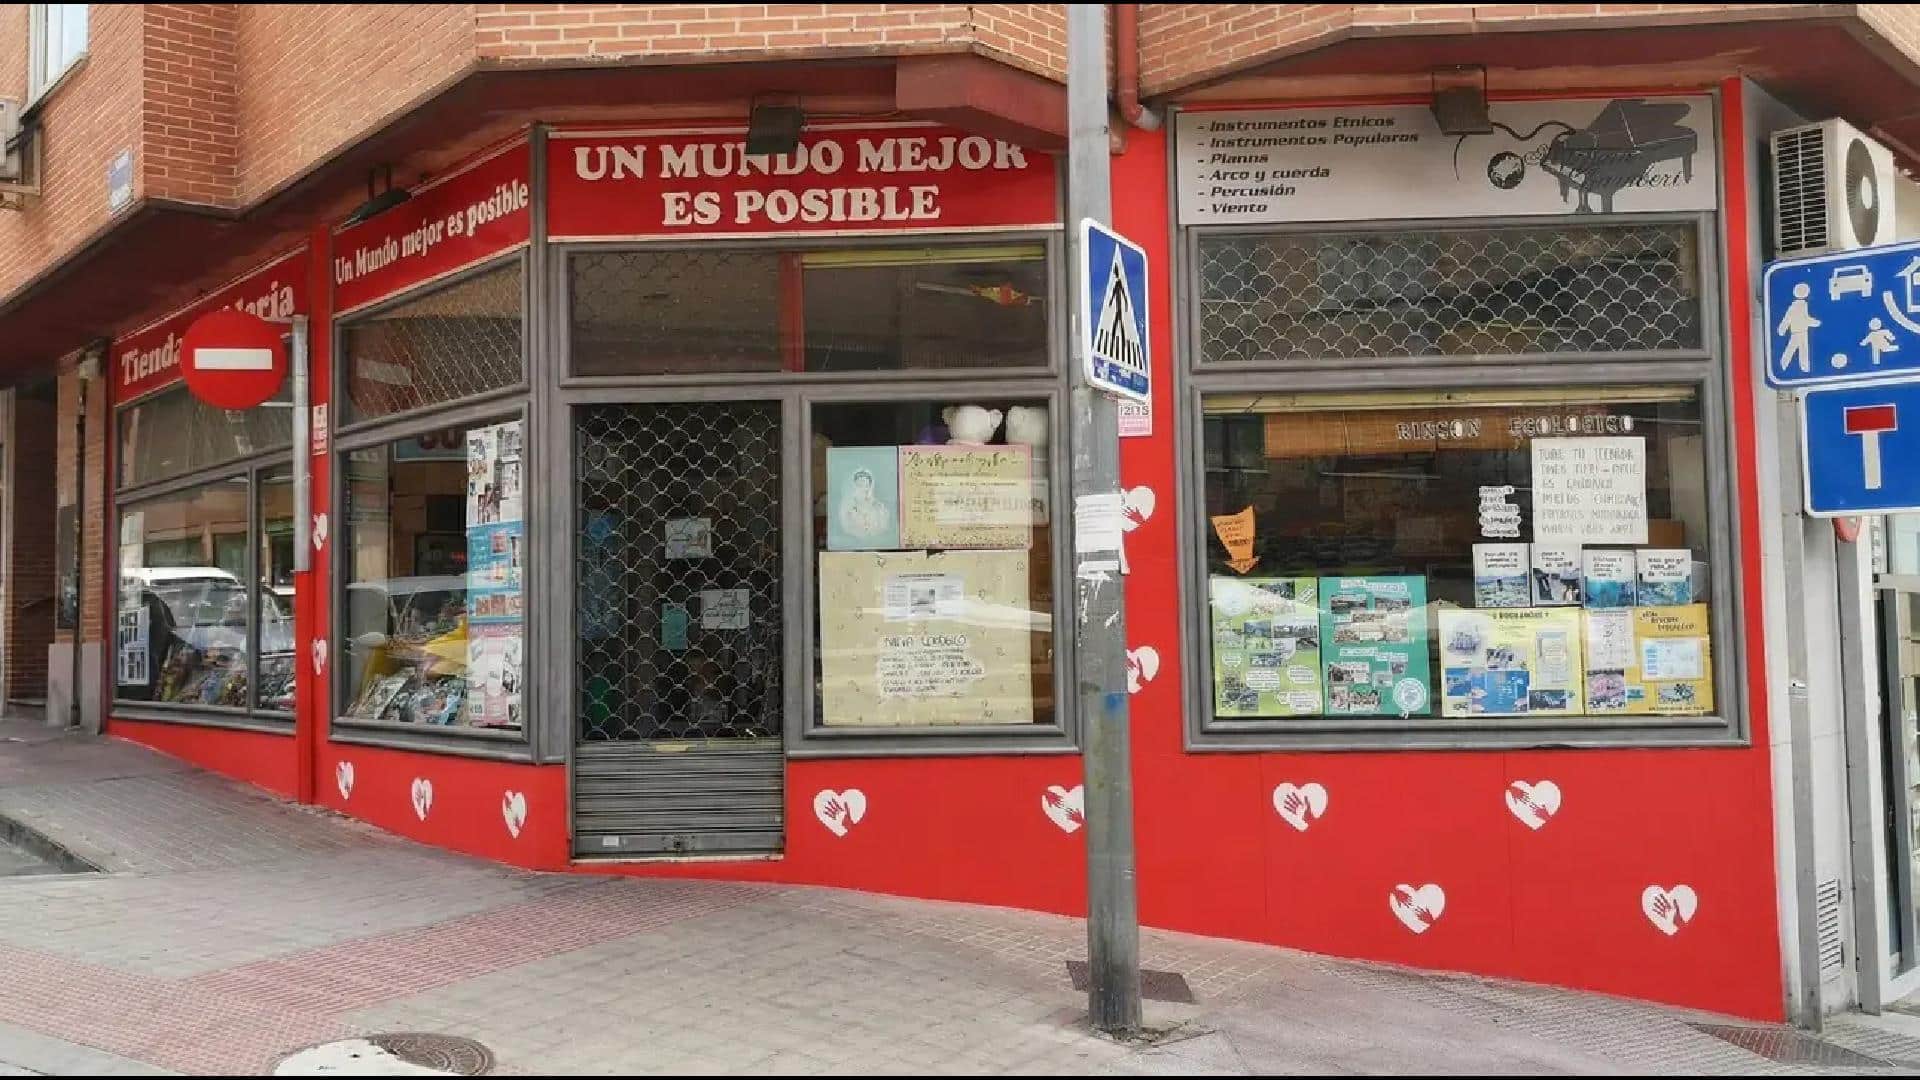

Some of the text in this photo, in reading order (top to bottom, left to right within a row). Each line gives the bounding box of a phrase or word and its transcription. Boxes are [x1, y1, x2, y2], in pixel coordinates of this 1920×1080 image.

[1209, 116, 1327, 132] Instrumentos
[1209, 134, 1327, 149] Instrumentos
[574, 136, 1028, 181] UN MUNDO MEJOR
[1210, 153, 1269, 165] Pianos
[1209, 166, 1330, 183] Arco y cuerda
[1210, 183, 1296, 198] Percusión
[661, 184, 941, 226] ES POSIBLE
[1211, 203, 1268, 215] Viento
[335, 177, 529, 285] Un Mundo mejor es posible
